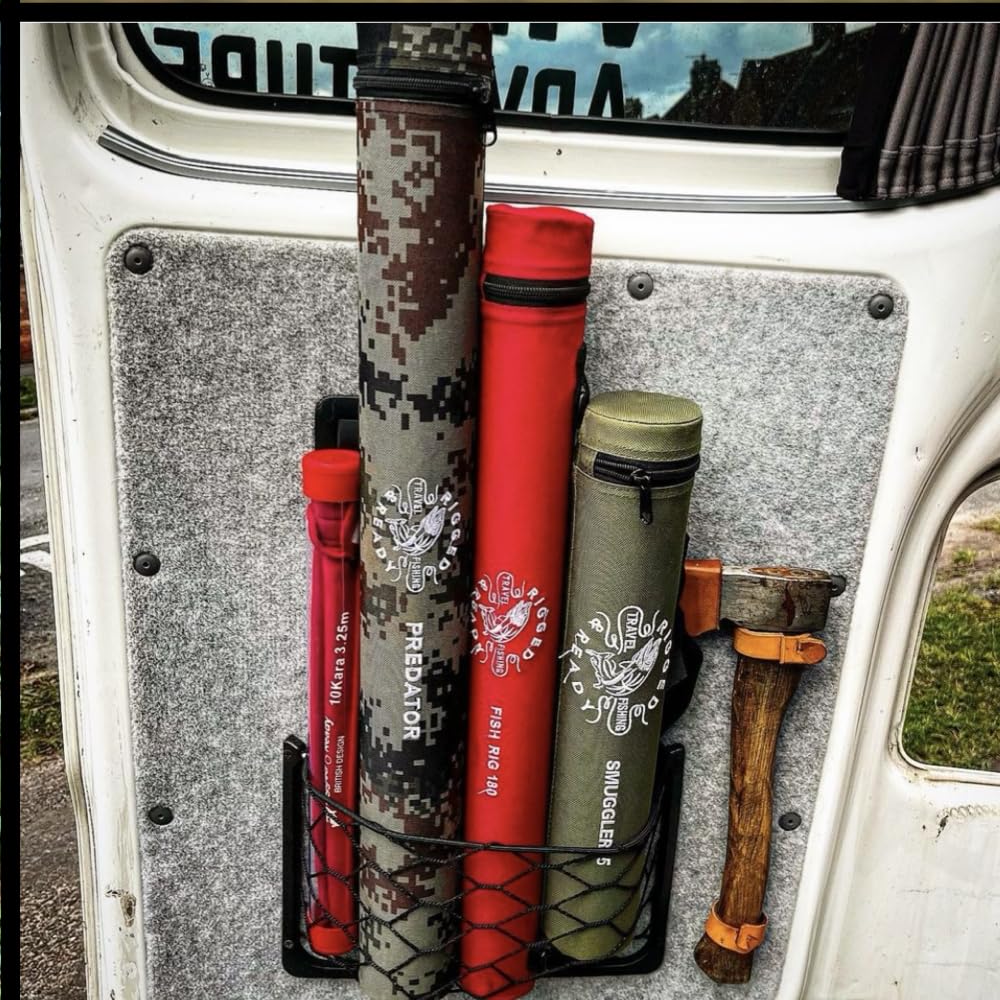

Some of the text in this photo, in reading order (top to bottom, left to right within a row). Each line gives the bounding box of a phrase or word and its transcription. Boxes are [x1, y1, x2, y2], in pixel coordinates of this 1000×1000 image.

[412, 480, 424, 515] TRAVEL
[439, 490, 462, 571] RIGGED
[371, 502, 399, 573] READY
[409, 555, 421, 590] FISHING
[500, 575, 512, 605] TRAVEL
[522, 587, 549, 660] RIGGED
[329, 611, 350, 706] 10Kara 3.25m
[496, 644, 506, 673] FISHING
[623, 611, 639, 652] TRAVEL
[648, 619, 673, 710] RIGGED
[403, 621, 423, 741] PREDATOR
[568, 628, 596, 711] READY
[615, 697, 629, 732] FISHING
[334, 735, 345, 793] BRITISH DESIGN
[486, 706, 503, 797] FISH RIG 180
[597, 759, 621, 867] SMUGGLER 5
